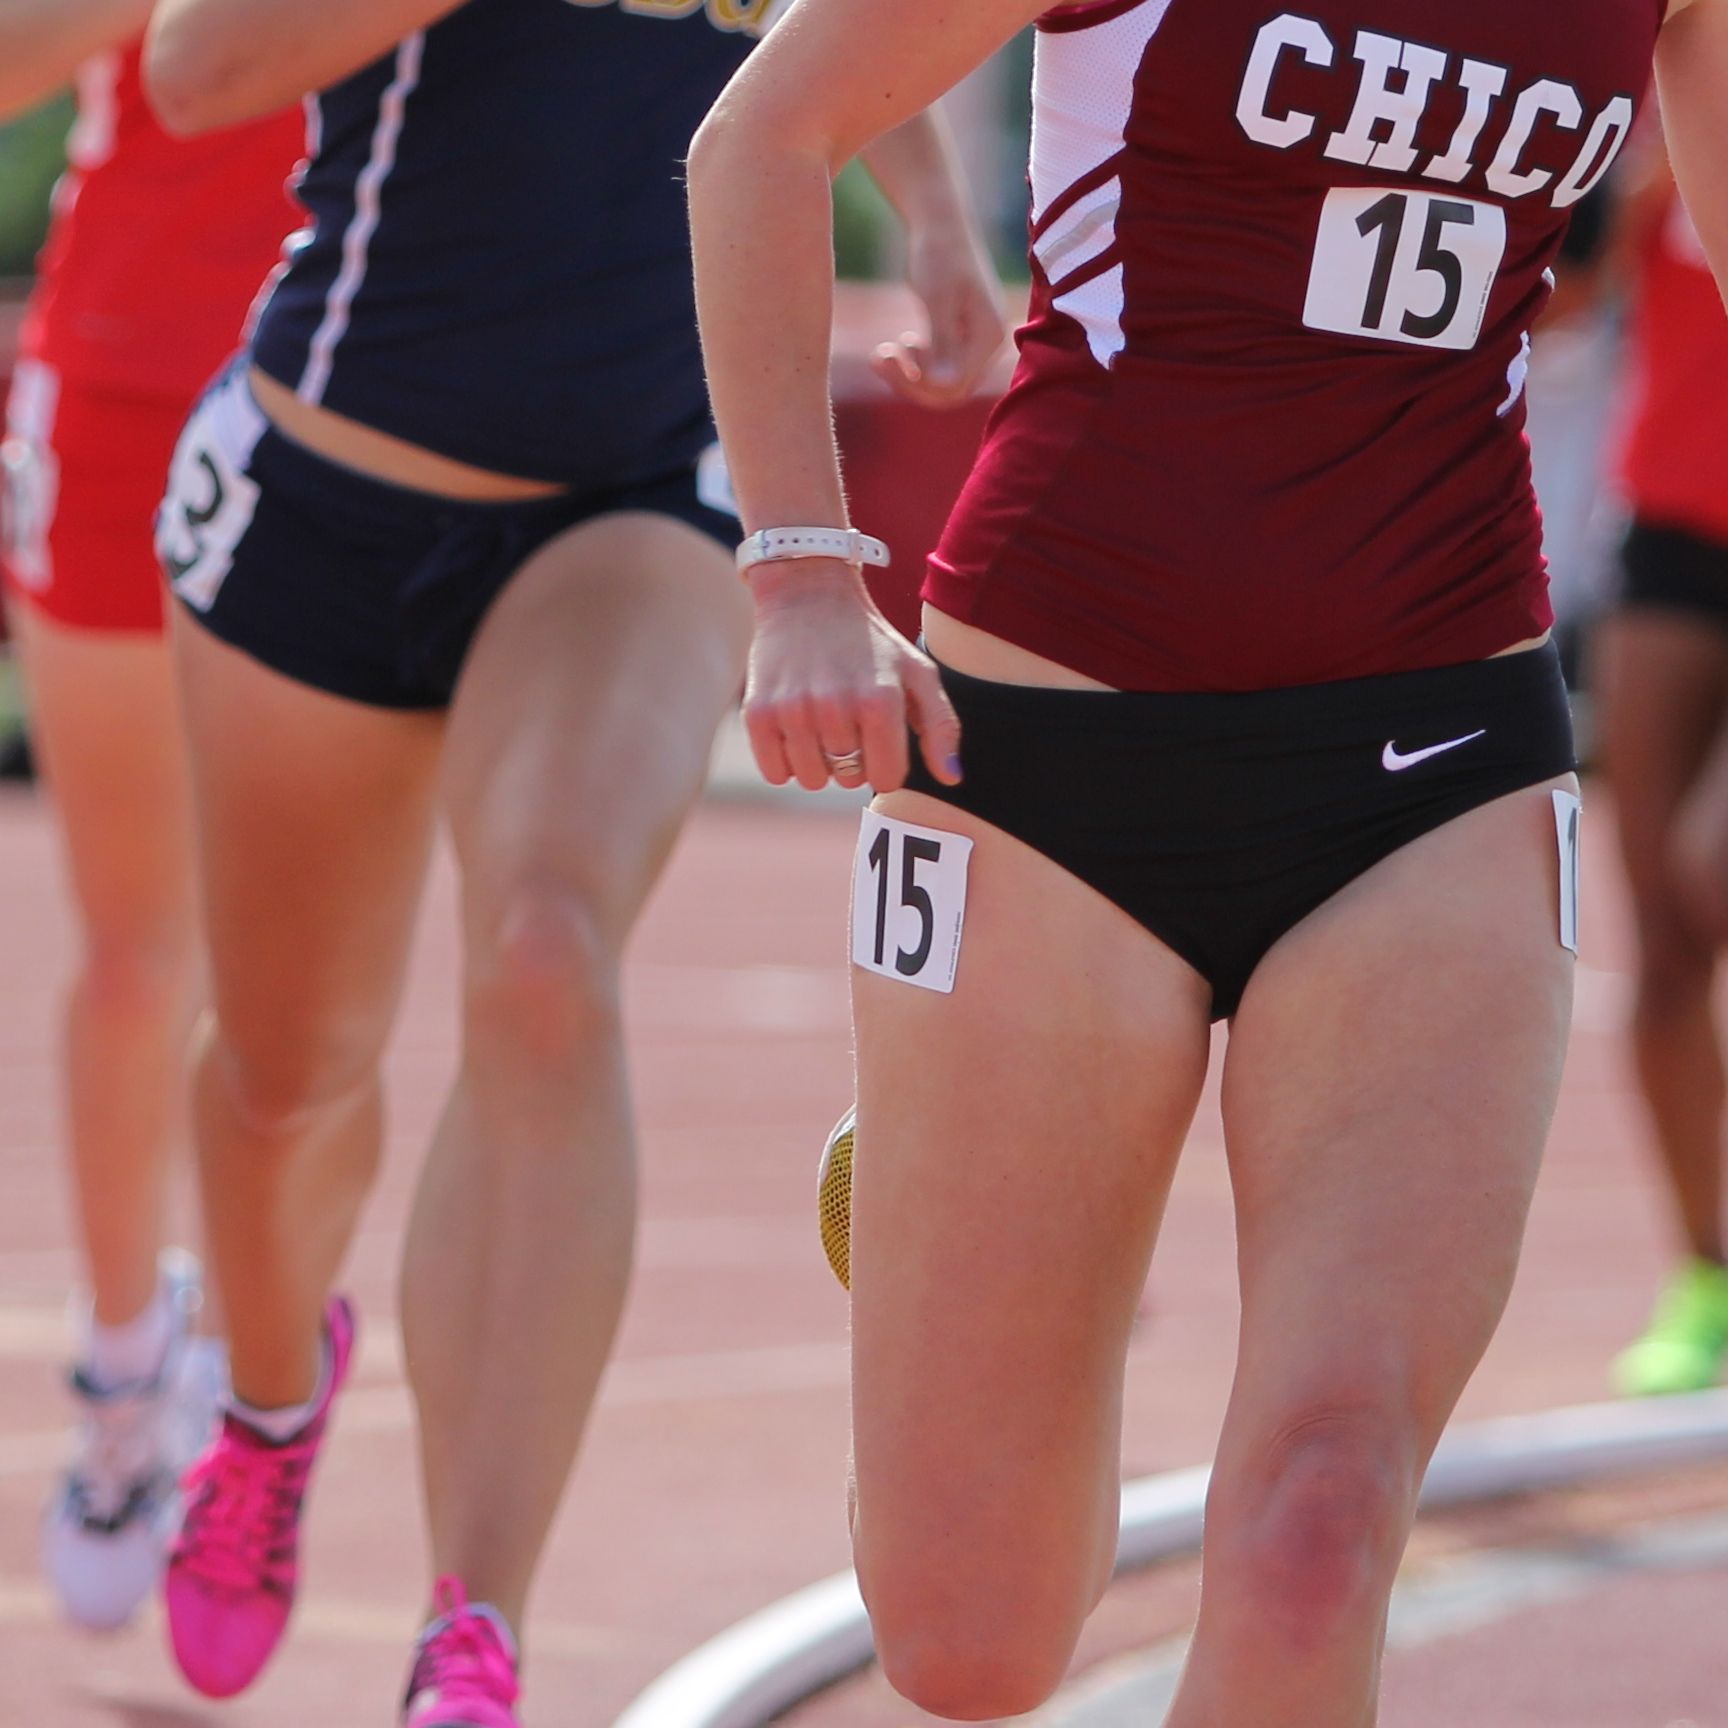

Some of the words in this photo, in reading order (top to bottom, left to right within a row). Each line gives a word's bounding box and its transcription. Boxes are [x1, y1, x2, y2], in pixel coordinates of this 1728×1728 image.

[1235, 13, 1633, 209] CHICO
[1355, 191, 1475, 340] 15
[869, 828, 941, 976] 15
